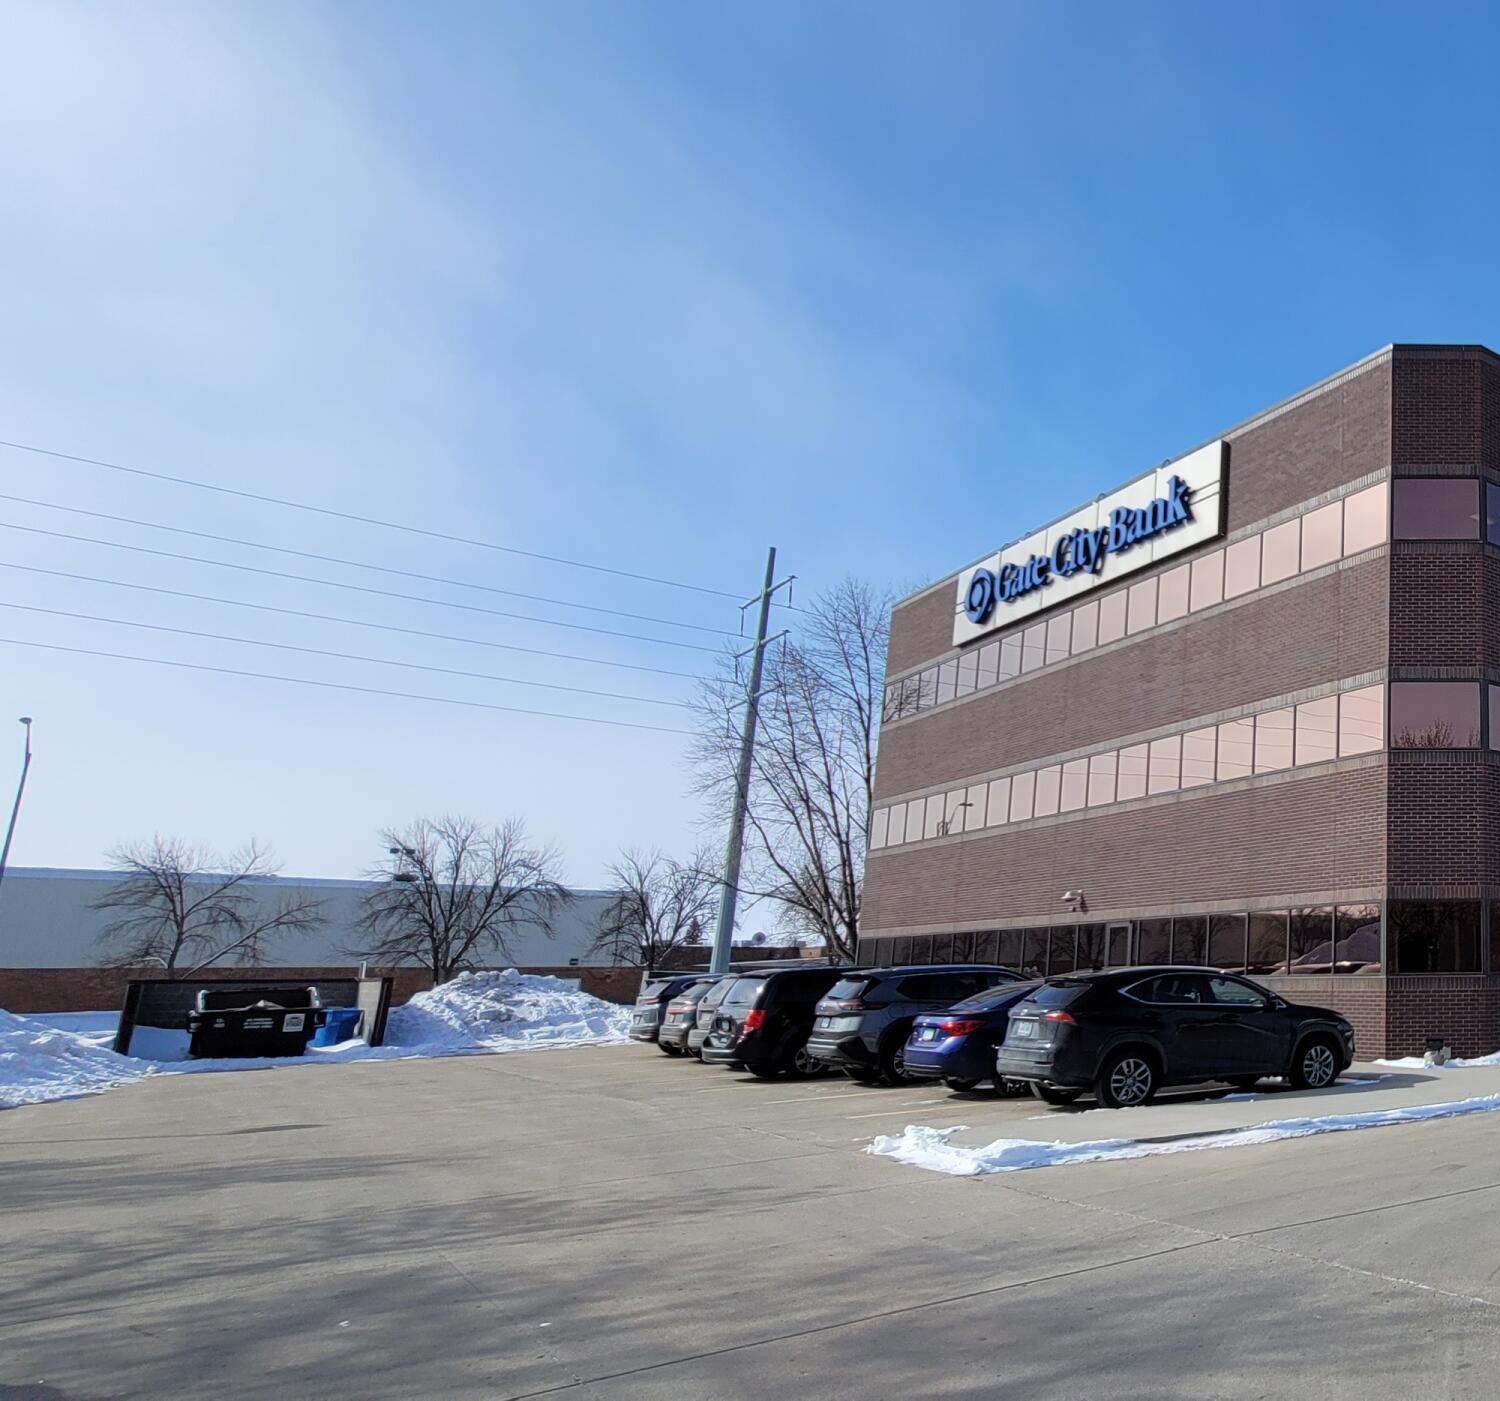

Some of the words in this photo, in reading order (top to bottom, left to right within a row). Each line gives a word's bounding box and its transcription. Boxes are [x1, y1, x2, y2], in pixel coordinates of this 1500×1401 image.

[994, 554, 1049, 602] Gate
[1050, 528, 1107, 575] City
[1106, 475, 1189, 553] Bank
